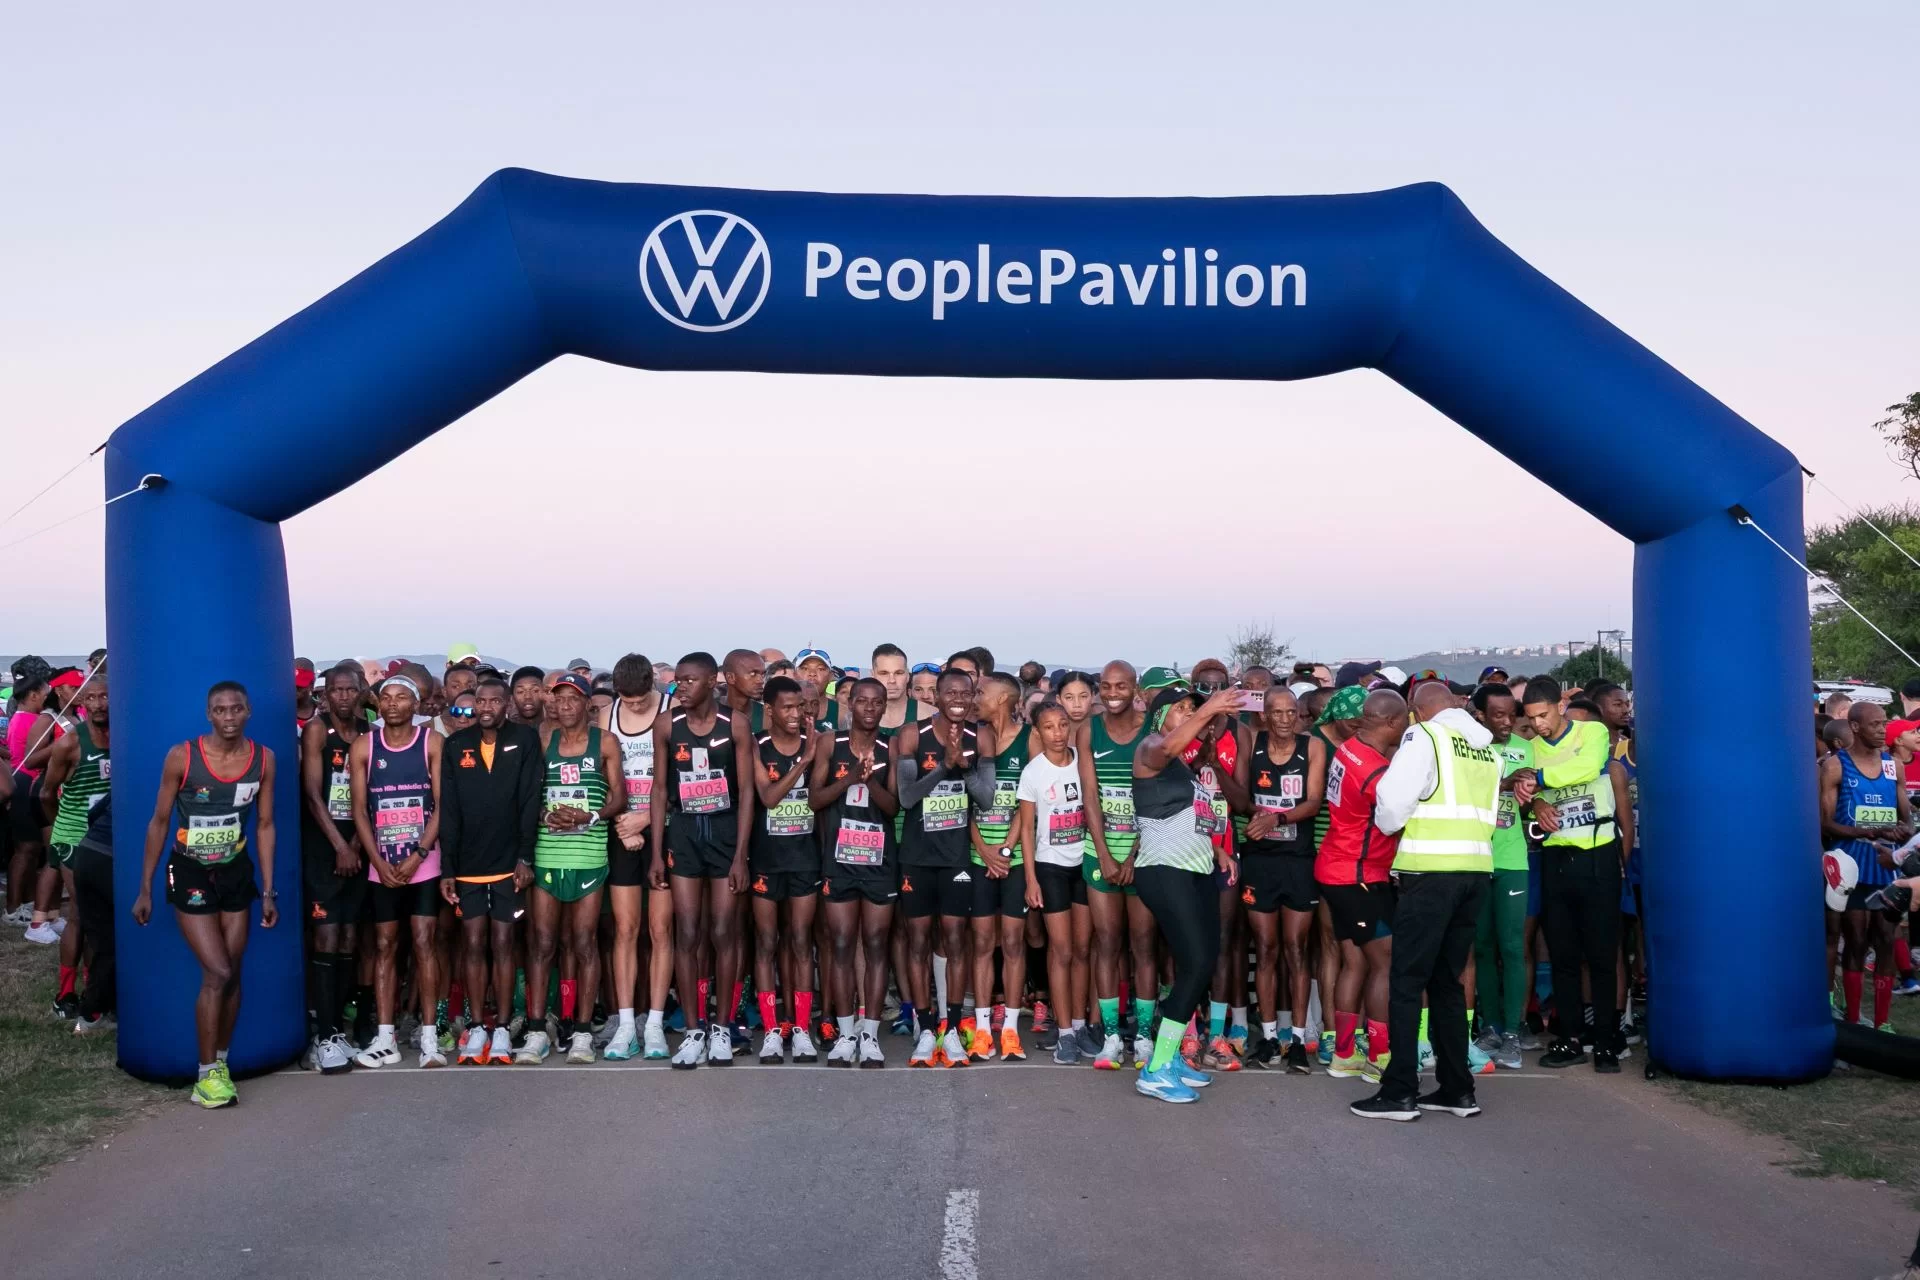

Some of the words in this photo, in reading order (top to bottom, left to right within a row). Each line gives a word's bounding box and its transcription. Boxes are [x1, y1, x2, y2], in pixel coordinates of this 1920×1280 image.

[805, 241, 1308, 320] PeoplePavilion
[627, 741, 652, 750] Varsi
[628, 750, 653, 759] Colle
[698, 756, 707, 769] J
[561, 765, 580, 784] 55
[1884, 763, 1895, 776] 45
[1200, 771, 1213, 785] 40
[398, 782, 422, 791] Athletics
[626, 781, 652, 794] 187
[686, 781, 723, 797] 1003
[1283, 777, 1301, 796] 60
[1554, 783, 1588, 801] 2157
[242, 787, 254, 802] J
[852, 786, 865, 803] J
[994, 793, 1012, 806] 63
[1864, 794, 1883, 805] ELITE
[775, 803, 811, 816] 2003
[929, 797, 964, 812] 2001
[1106, 801, 1131, 815] 248
[1498, 799, 1514, 812] 79
[381, 811, 418, 824] 1939
[1861, 810, 1894, 822] 2173
[194, 830, 235, 845] 2638
[844, 832, 879, 847] 1698
[842, 847, 860, 855] ROAD
